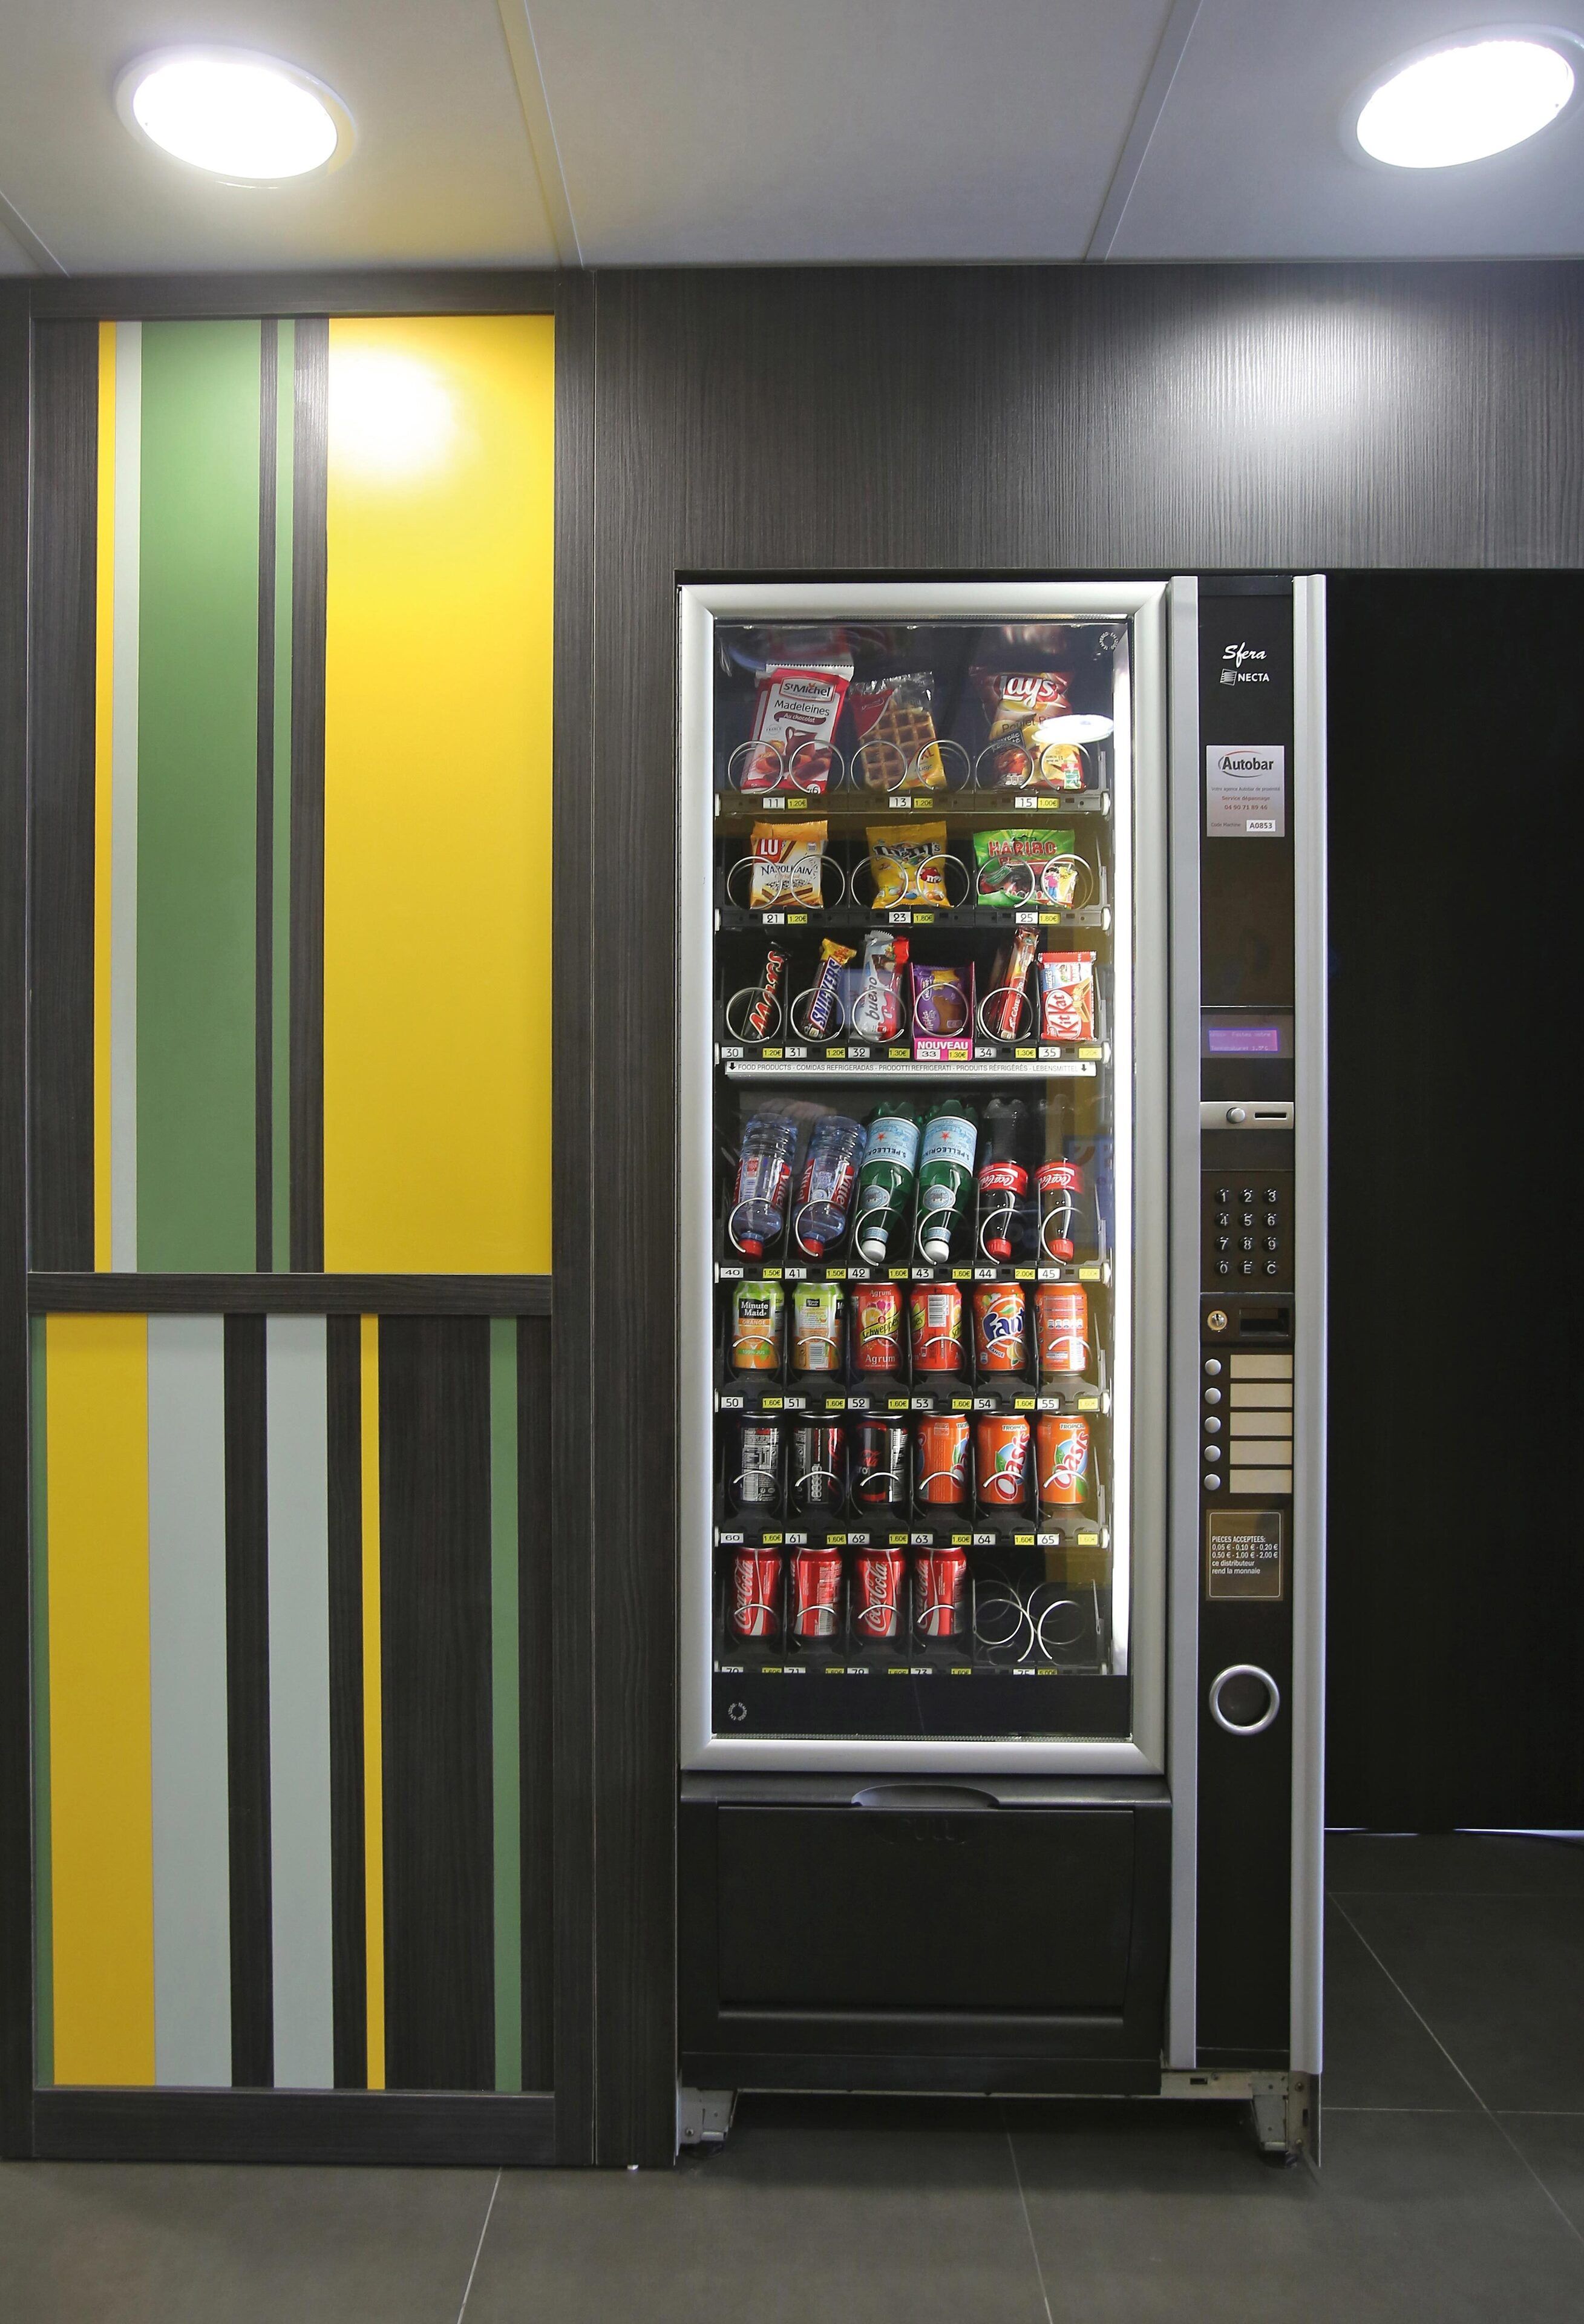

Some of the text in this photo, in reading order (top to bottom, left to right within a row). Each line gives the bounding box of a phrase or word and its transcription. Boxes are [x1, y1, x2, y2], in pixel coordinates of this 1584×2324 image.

[1222, 642, 1267, 668] Sfera
[1237, 672, 1270, 682] NECTA
[774, 699, 830, 717] Madeleines
[792, 714, 815, 723] chocolat
[1002, 718, 1035, 733] Poulet
[1222, 757, 1274, 770] Autobar
[769, 799, 778, 807] 11
[1021, 798, 1032, 807] 15
[761, 839, 779, 855] LU
[988, 840, 1056, 857] HARIBO
[767, 914, 777, 923] 21
[917, 1041, 969, 1049] NOUVEAU
[853, 1048, 865, 1057] 32
[980, 1048, 992, 1057] 34
[1044, 1048, 1056, 1057] 35
[1222, 1192, 1276, 1203] 1 2 3
[1220, 1216, 1275, 1226] 4 5 6
[1220, 1239, 1275, 1250] 7 8 9
[790, 1269, 799, 1278] 41
[979, 1269, 991, 1278] 44
[1220, 1264, 1276, 1274] 0 E C
[1042, 1270, 1055, 1278] 45
[982, 1308, 1024, 1342] Fant
[988, 1345, 1005, 1359] RANGE
[865, 1354, 895, 1364] Agrum
[789, 1399, 799, 1407] 51
[917, 1399, 928, 1408] 53
[853, 1535, 865, 1543] 62
[1042, 1535, 1054, 1544] 65
